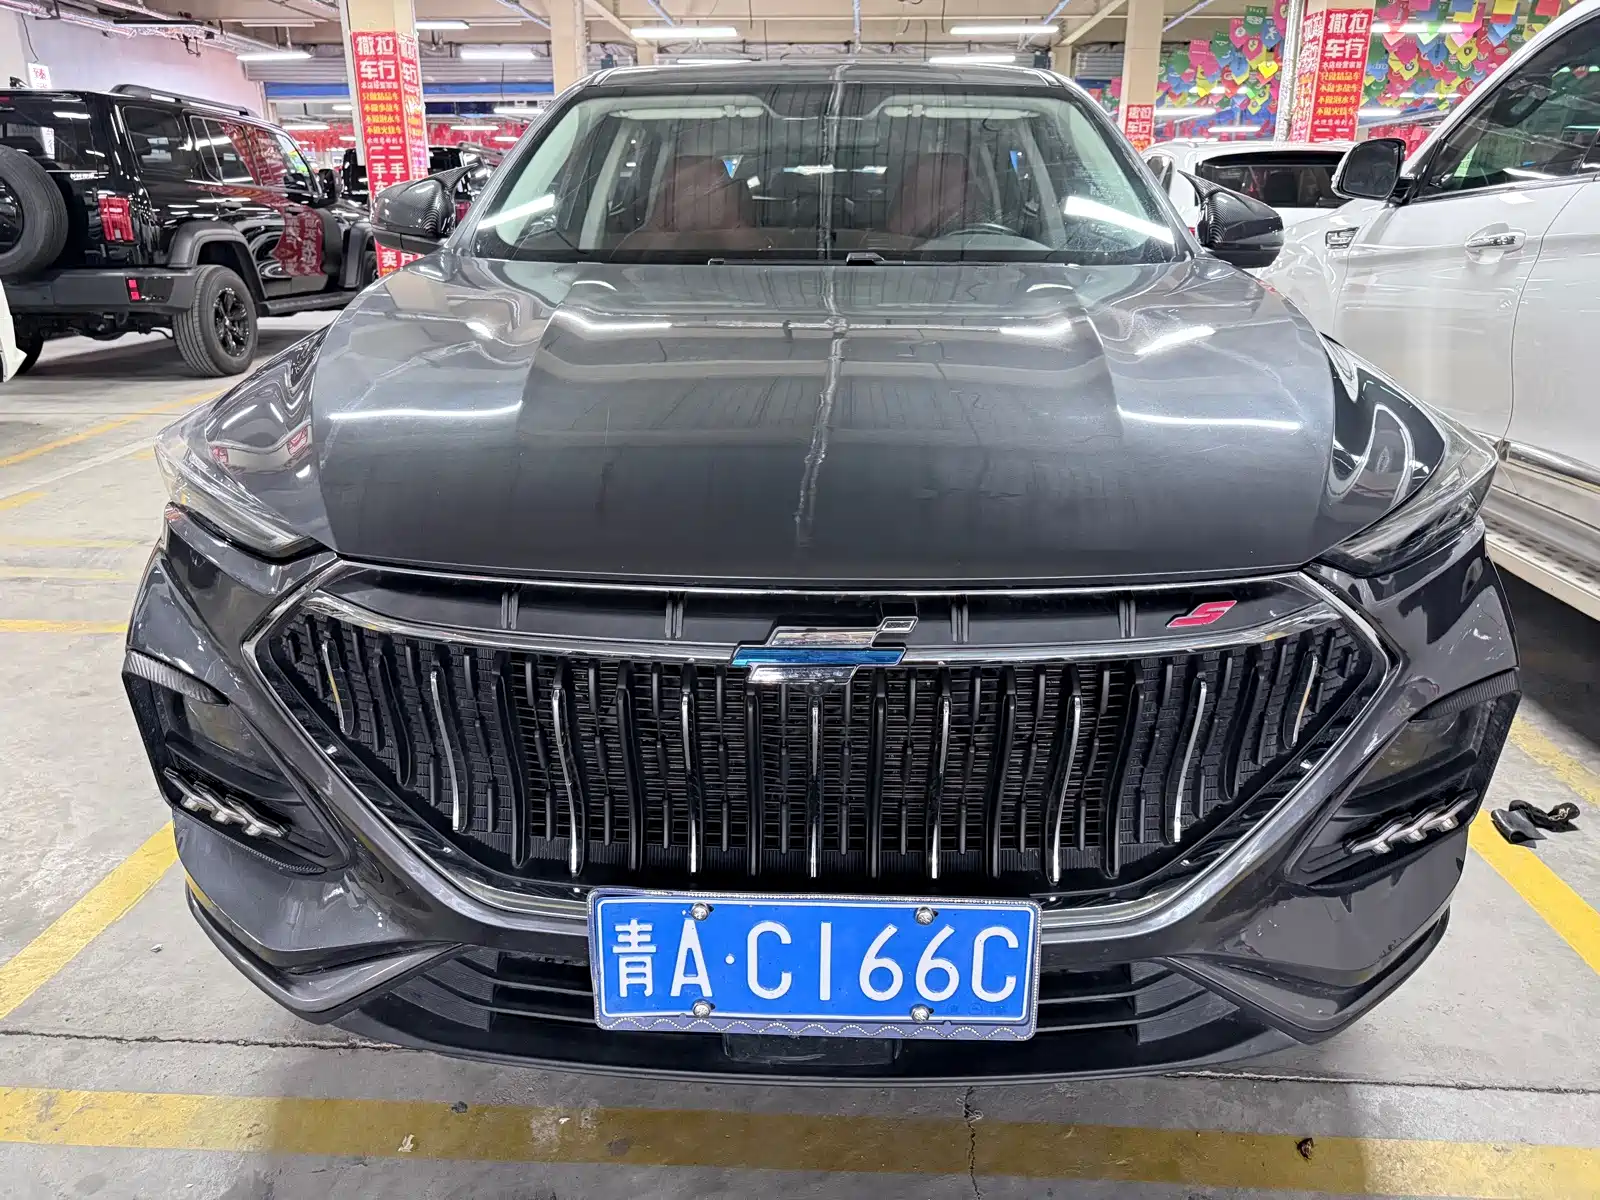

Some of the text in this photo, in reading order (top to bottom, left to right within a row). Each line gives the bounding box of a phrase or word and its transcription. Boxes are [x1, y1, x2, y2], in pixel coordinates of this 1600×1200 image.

[1327, 12, 1369, 34] 撒拉
[356, 36, 394, 55] 撒拉
[1324, 38, 1365, 59] 车行
[360, 60, 396, 80] 车行
